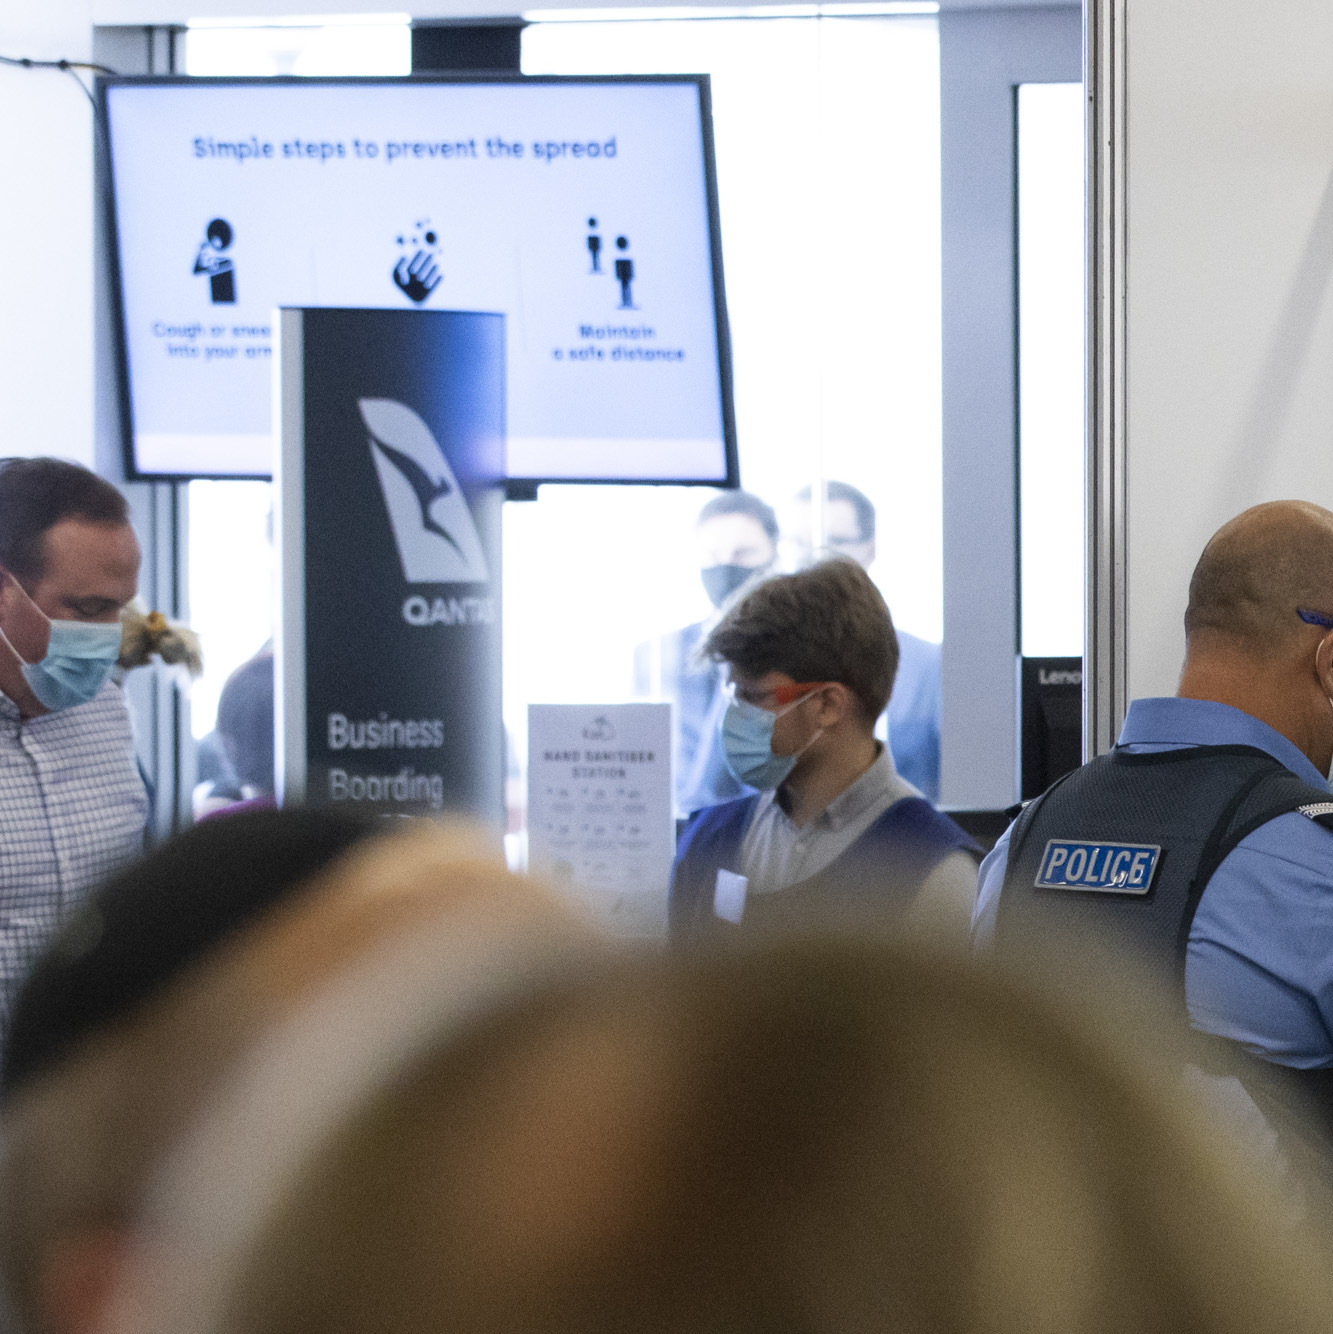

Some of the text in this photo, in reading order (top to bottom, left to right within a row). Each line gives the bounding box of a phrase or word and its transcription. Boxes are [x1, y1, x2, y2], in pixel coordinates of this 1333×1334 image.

[193, 135, 618, 165] Simple steps to prevent the spread
[1038, 668, 1082, 685] Leno
[327, 712, 445, 750] Business
[328, 766, 445, 810] Boarding
[1044, 847, 1150, 885] POLICE
